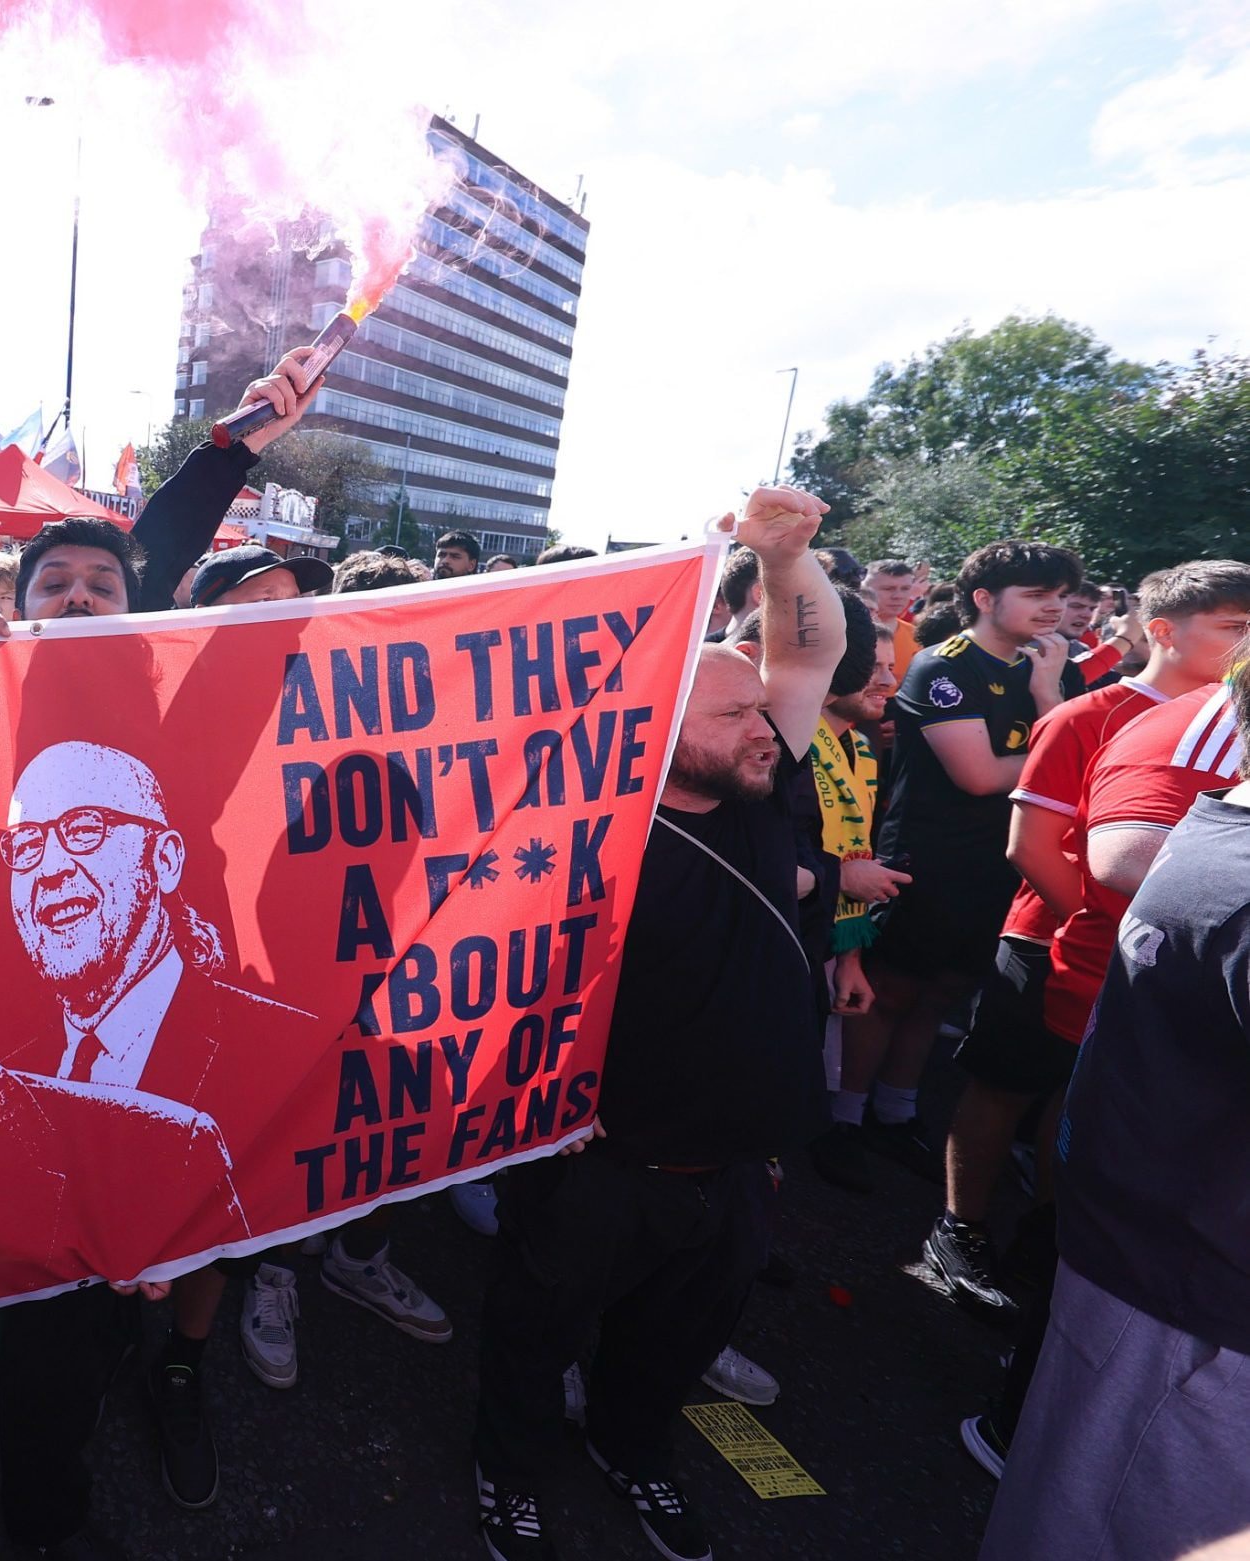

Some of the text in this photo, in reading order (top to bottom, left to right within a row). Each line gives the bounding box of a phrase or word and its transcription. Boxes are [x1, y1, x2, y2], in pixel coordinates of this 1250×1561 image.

[276, 640, 436, 746] AND
[455, 605, 655, 723] THEY
[281, 738, 498, 856] DON'T
[815, 771, 835, 809] GOLD
[817, 728, 842, 763] SOLD
[336, 864, 396, 962] A
[334, 1003, 582, 1134] ANY OF
[294, 1071, 598, 1213] THE FANS
